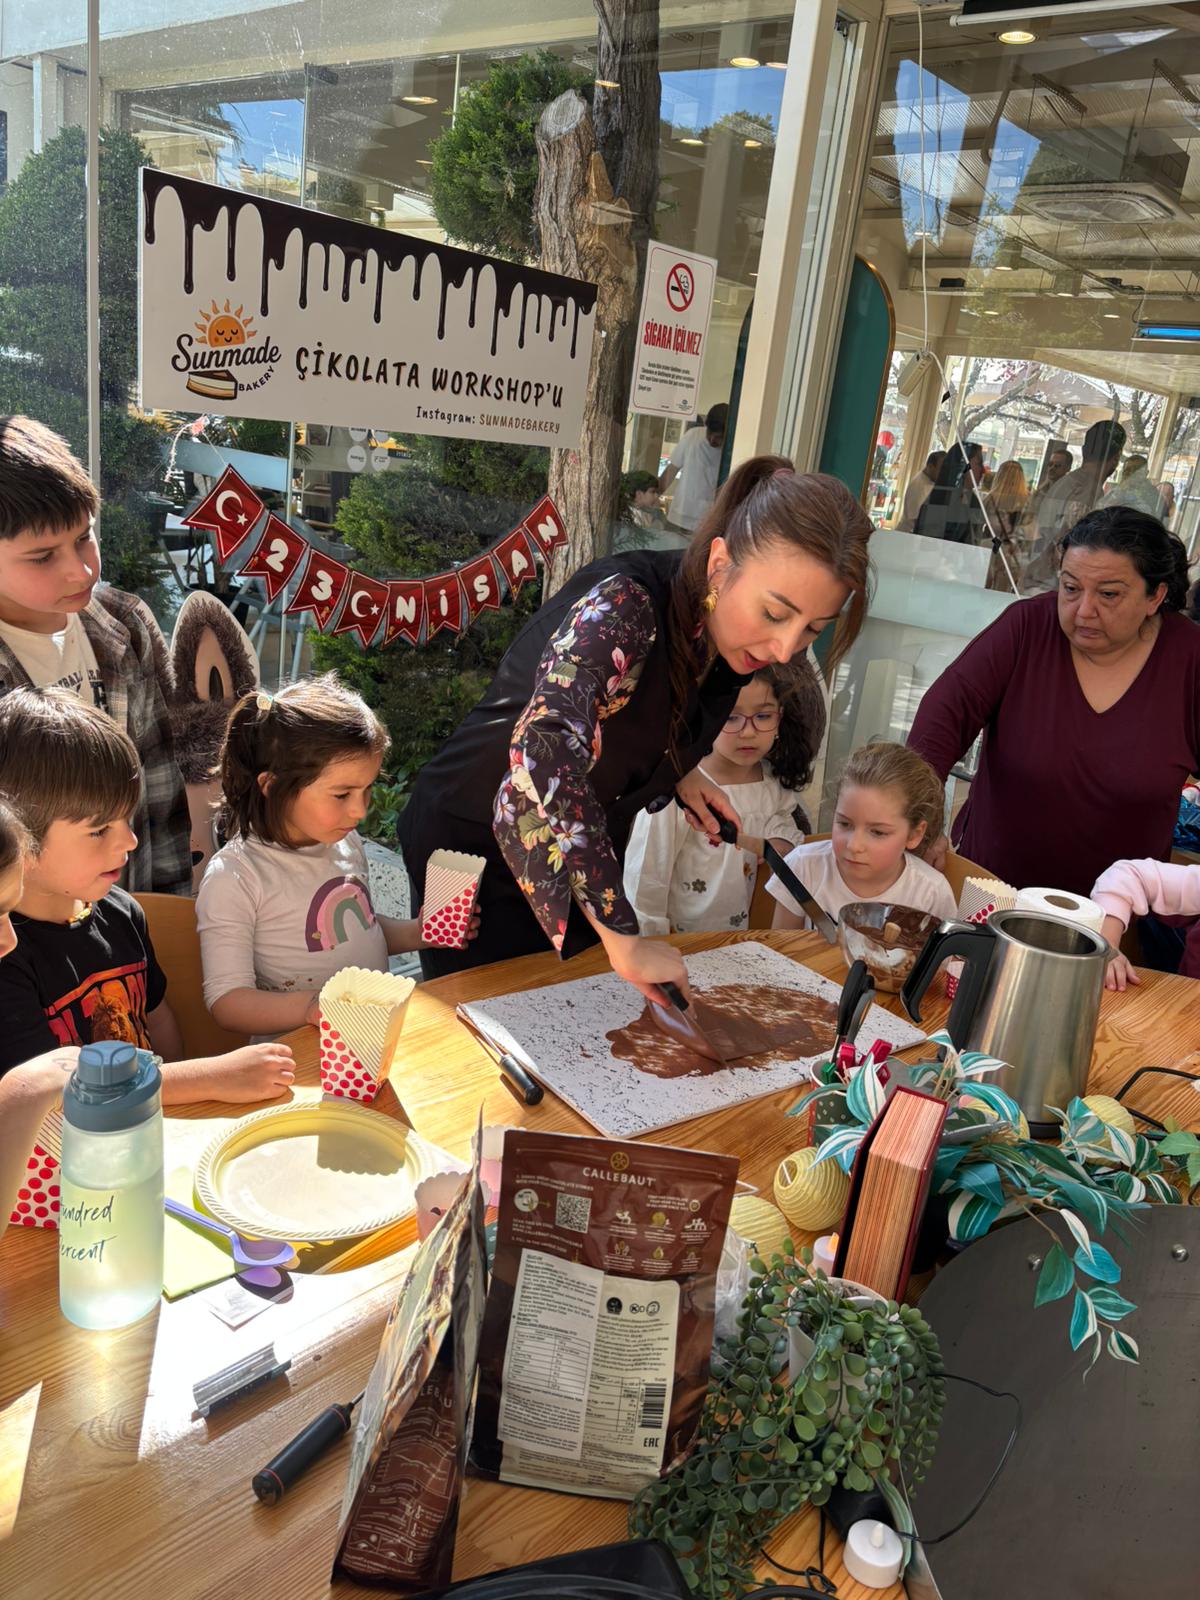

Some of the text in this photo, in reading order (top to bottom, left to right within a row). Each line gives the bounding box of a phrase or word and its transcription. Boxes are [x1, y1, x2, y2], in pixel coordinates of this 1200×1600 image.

[171, 333, 282, 372] Sunmade
[643, 318, 703, 356] SİGARA İÇİLMEZ
[238, 366, 275, 392] BAKERY
[296, 342, 564, 408] ÇİKOLATA WORKSHOP'U
[416, 405, 560, 434] Instagram: SUNMADEBAKERY
[582, 1166, 653, 1187] CALLEBAUT
